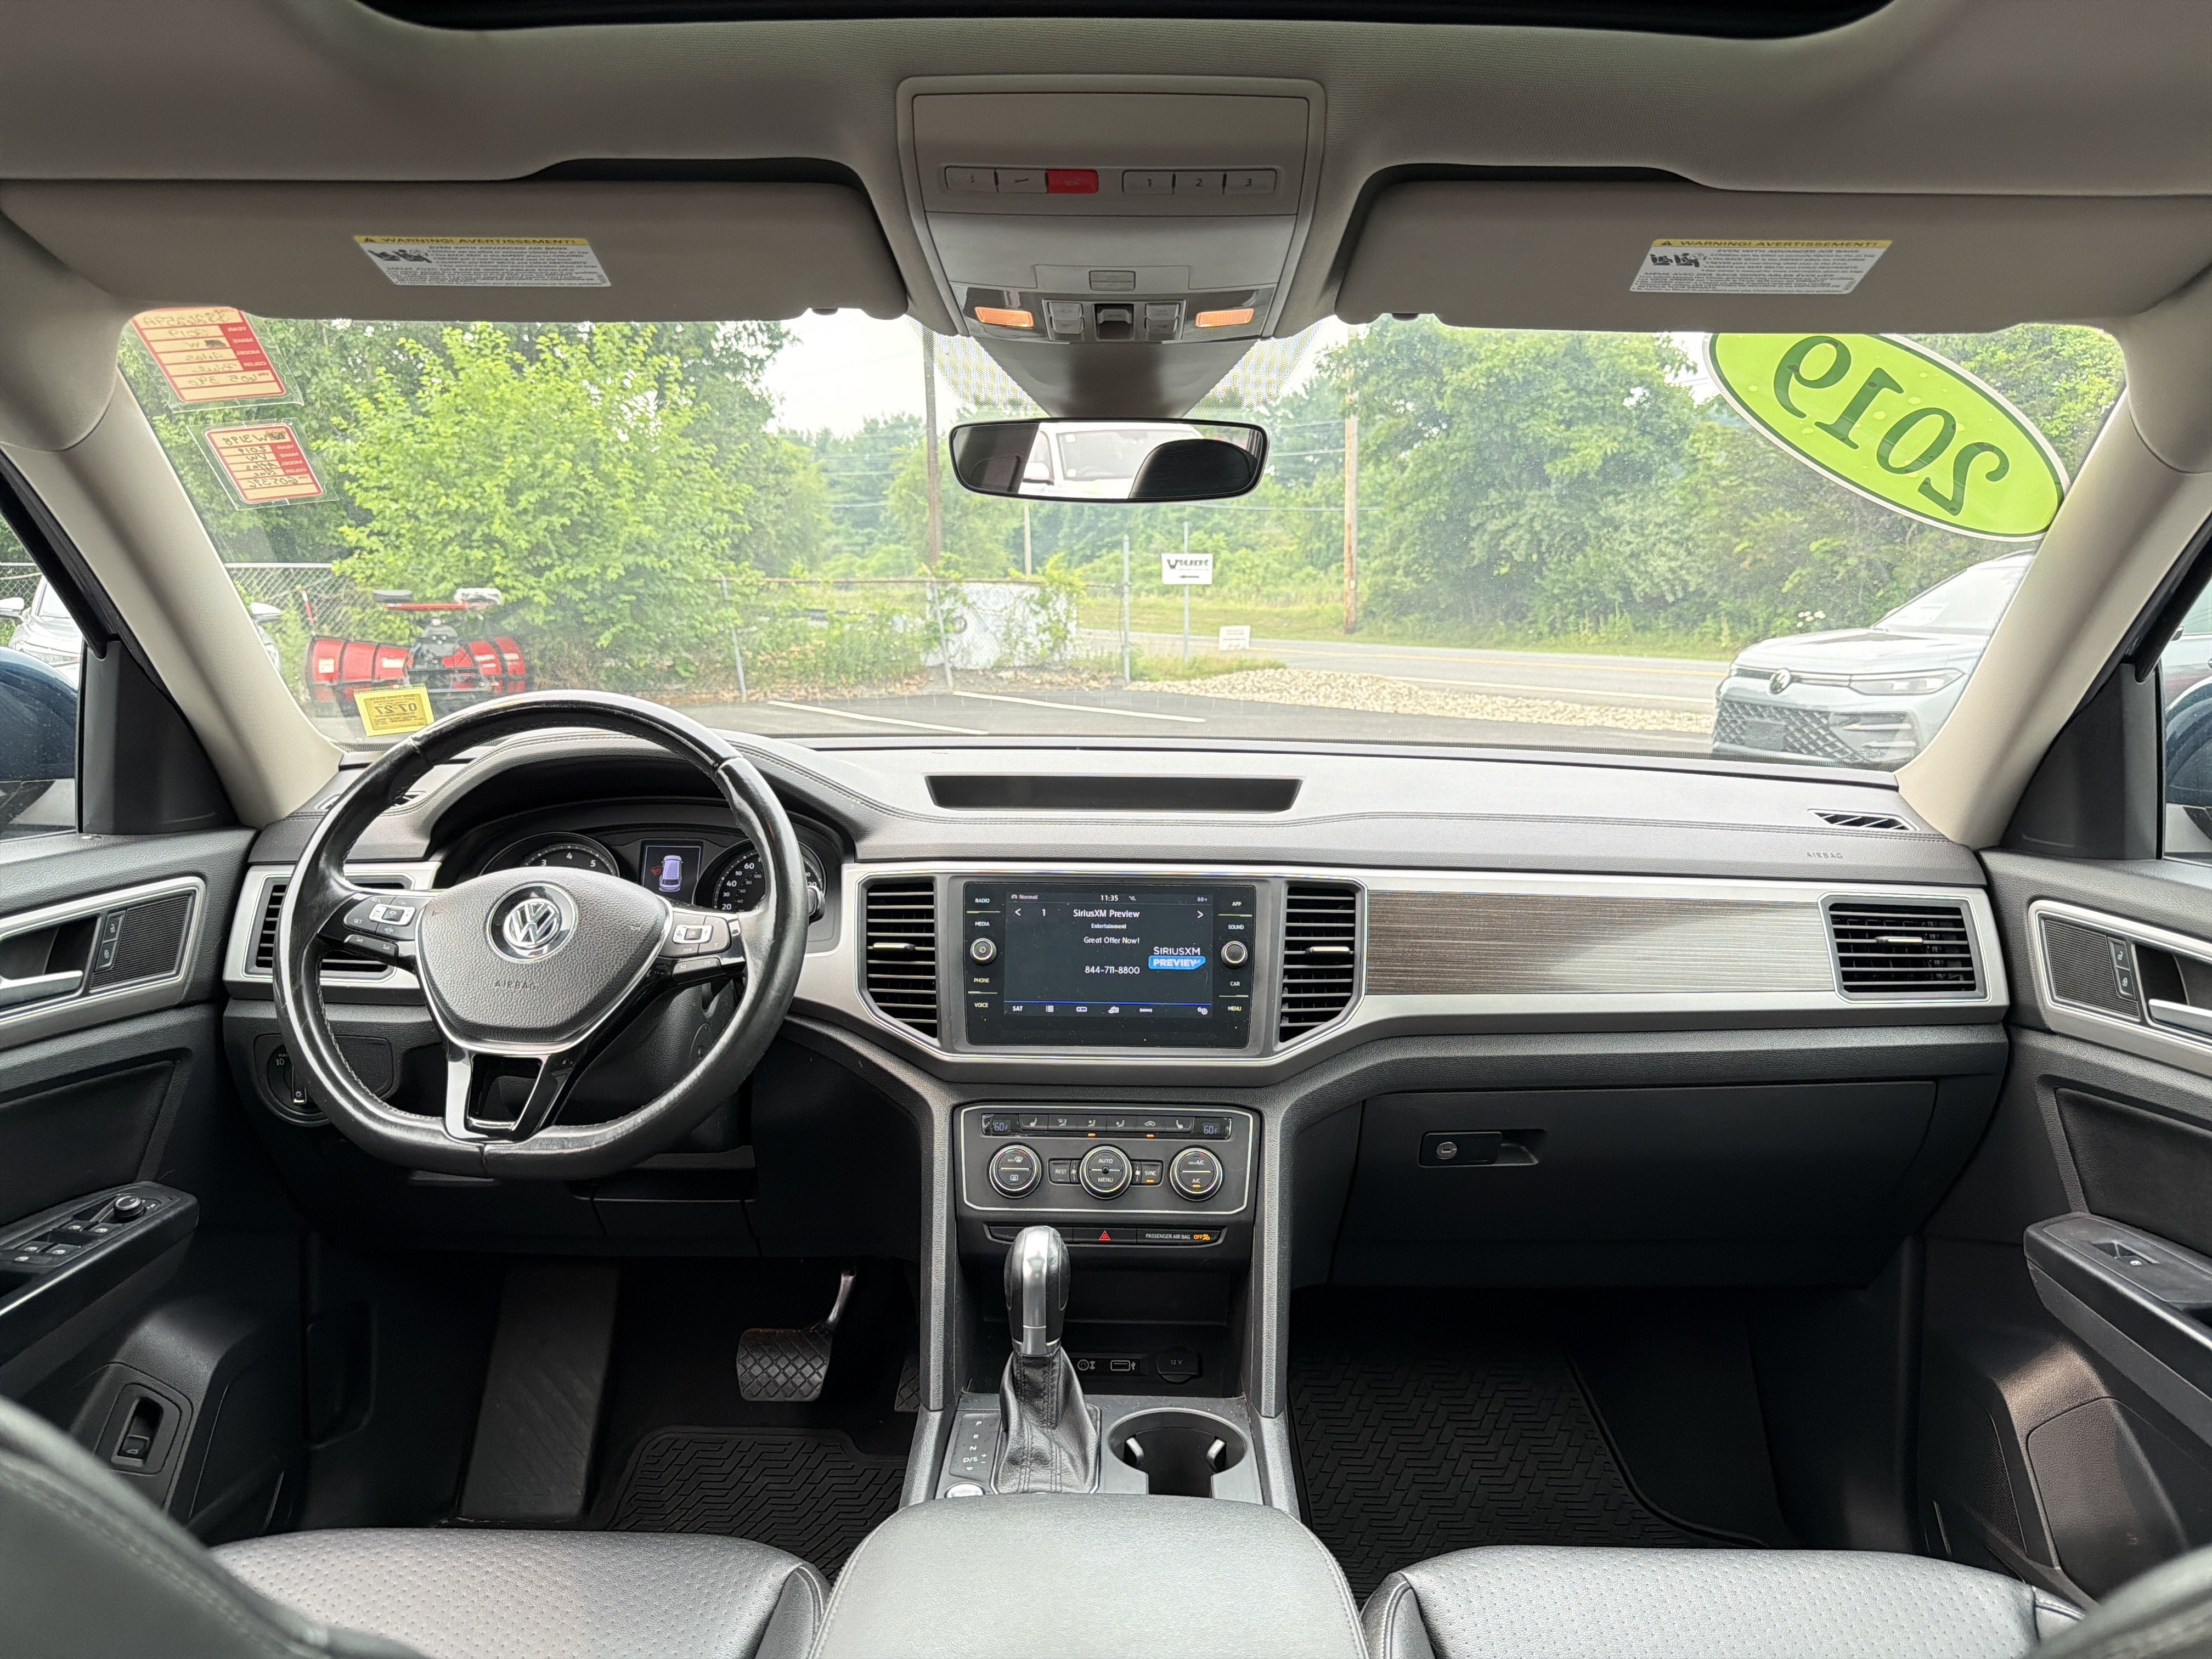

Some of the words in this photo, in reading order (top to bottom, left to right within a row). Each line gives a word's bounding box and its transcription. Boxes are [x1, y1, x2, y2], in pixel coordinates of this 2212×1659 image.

[1147, 179, 1152, 187] 1
[1195, 178, 1203, 187] 2
[1245, 178, 1252, 187] 3
[589, 859, 596, 867] 5
[1073, 909, 1107, 918] SiriusXM
[1109, 909, 1140, 918] Preview
[1153, 946, 1201, 955] SIRIUSXM
[1153, 958, 1201, 967] PREVIEW
[1085, 966, 1140, 974] 844-711-8800
[495, 980, 538, 991] AIRBAG
